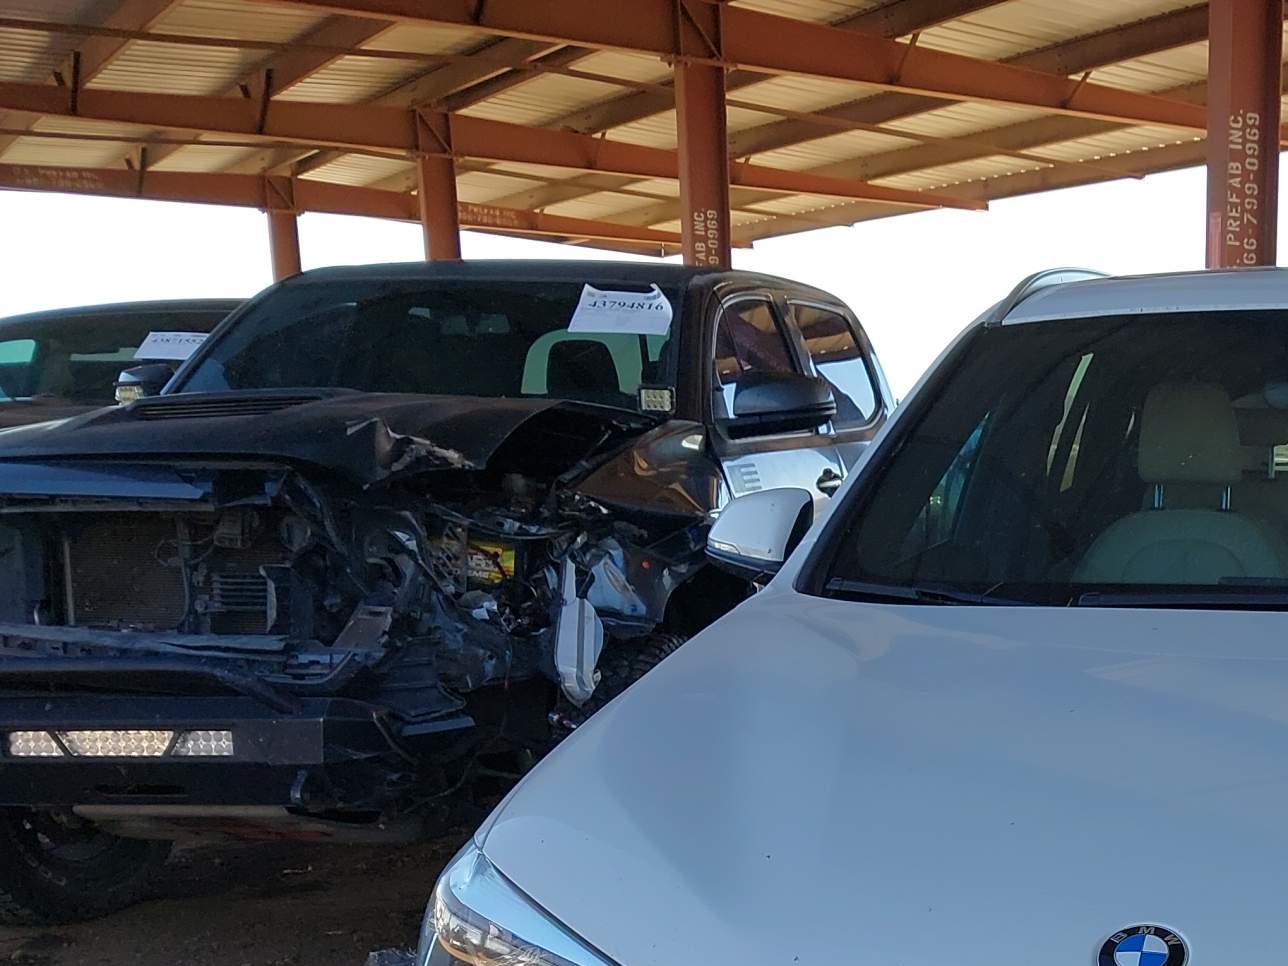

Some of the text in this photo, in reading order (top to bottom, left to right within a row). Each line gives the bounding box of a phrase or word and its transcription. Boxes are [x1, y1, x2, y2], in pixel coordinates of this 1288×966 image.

[1228, 109, 1244, 150] INC.
[1226, 161, 1242, 246] PREFAB
[1242, 112, 1260, 265] 66-799-0969
[693, 208, 706, 236] INC.
[1110, 926, 1181, 946] BMW
